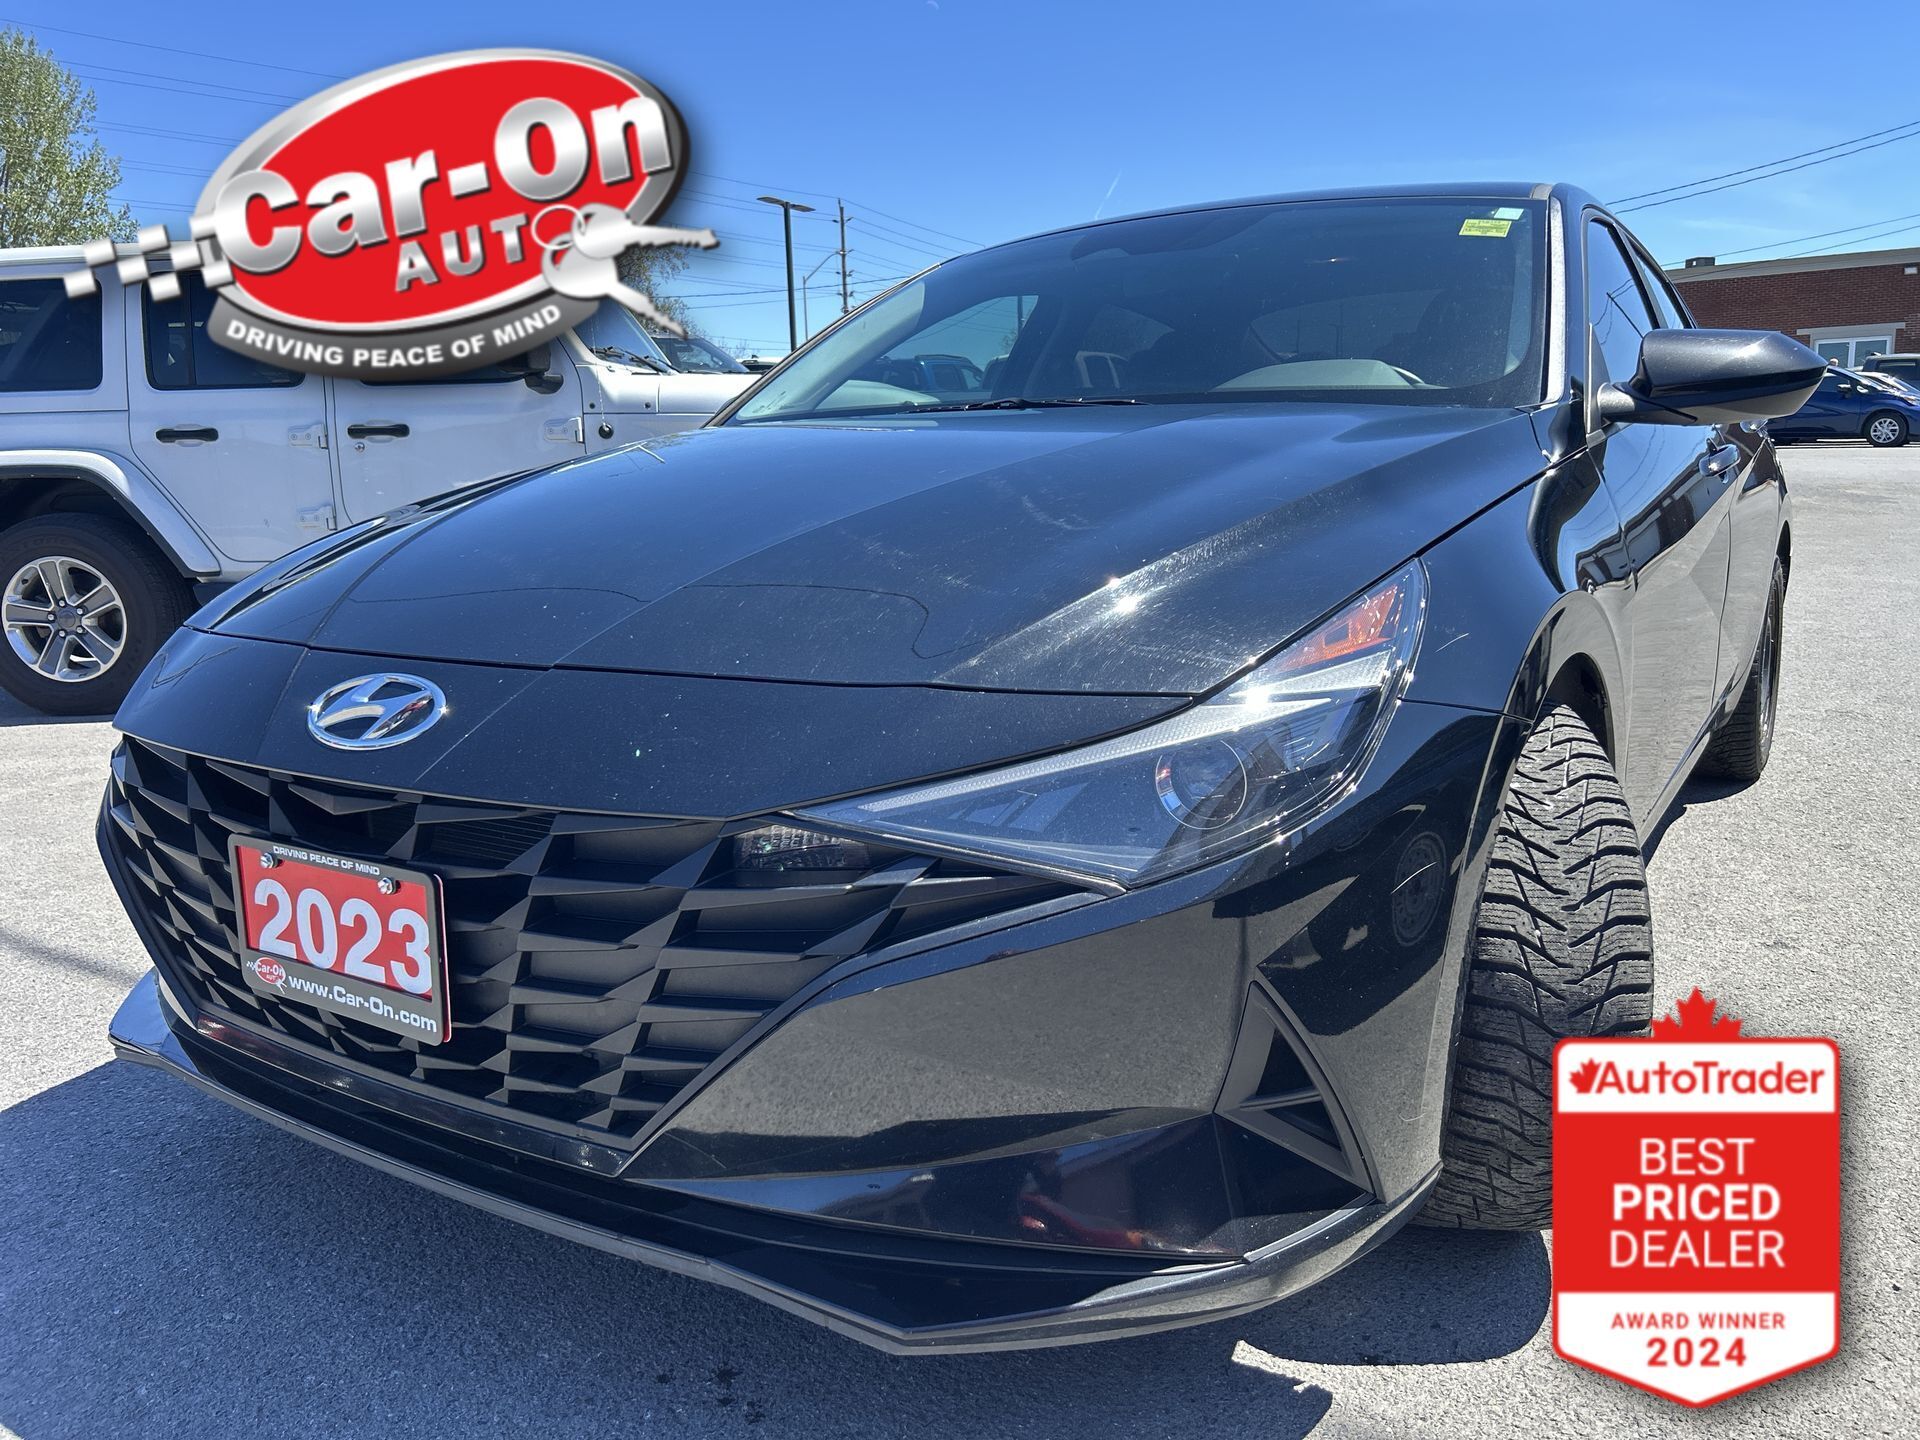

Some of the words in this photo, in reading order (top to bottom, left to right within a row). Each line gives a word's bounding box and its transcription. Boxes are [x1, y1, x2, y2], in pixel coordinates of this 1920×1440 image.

[273, 845, 308, 861] DRIVING
[309, 853, 340, 867] PEACE
[341, 860, 354, 869] OF
[355, 863, 380, 876] MIND
[254, 878, 433, 995] 2023
[255, 961, 286, 977] Car-On
[288, 975, 438, 1033] www.Car-On.com
